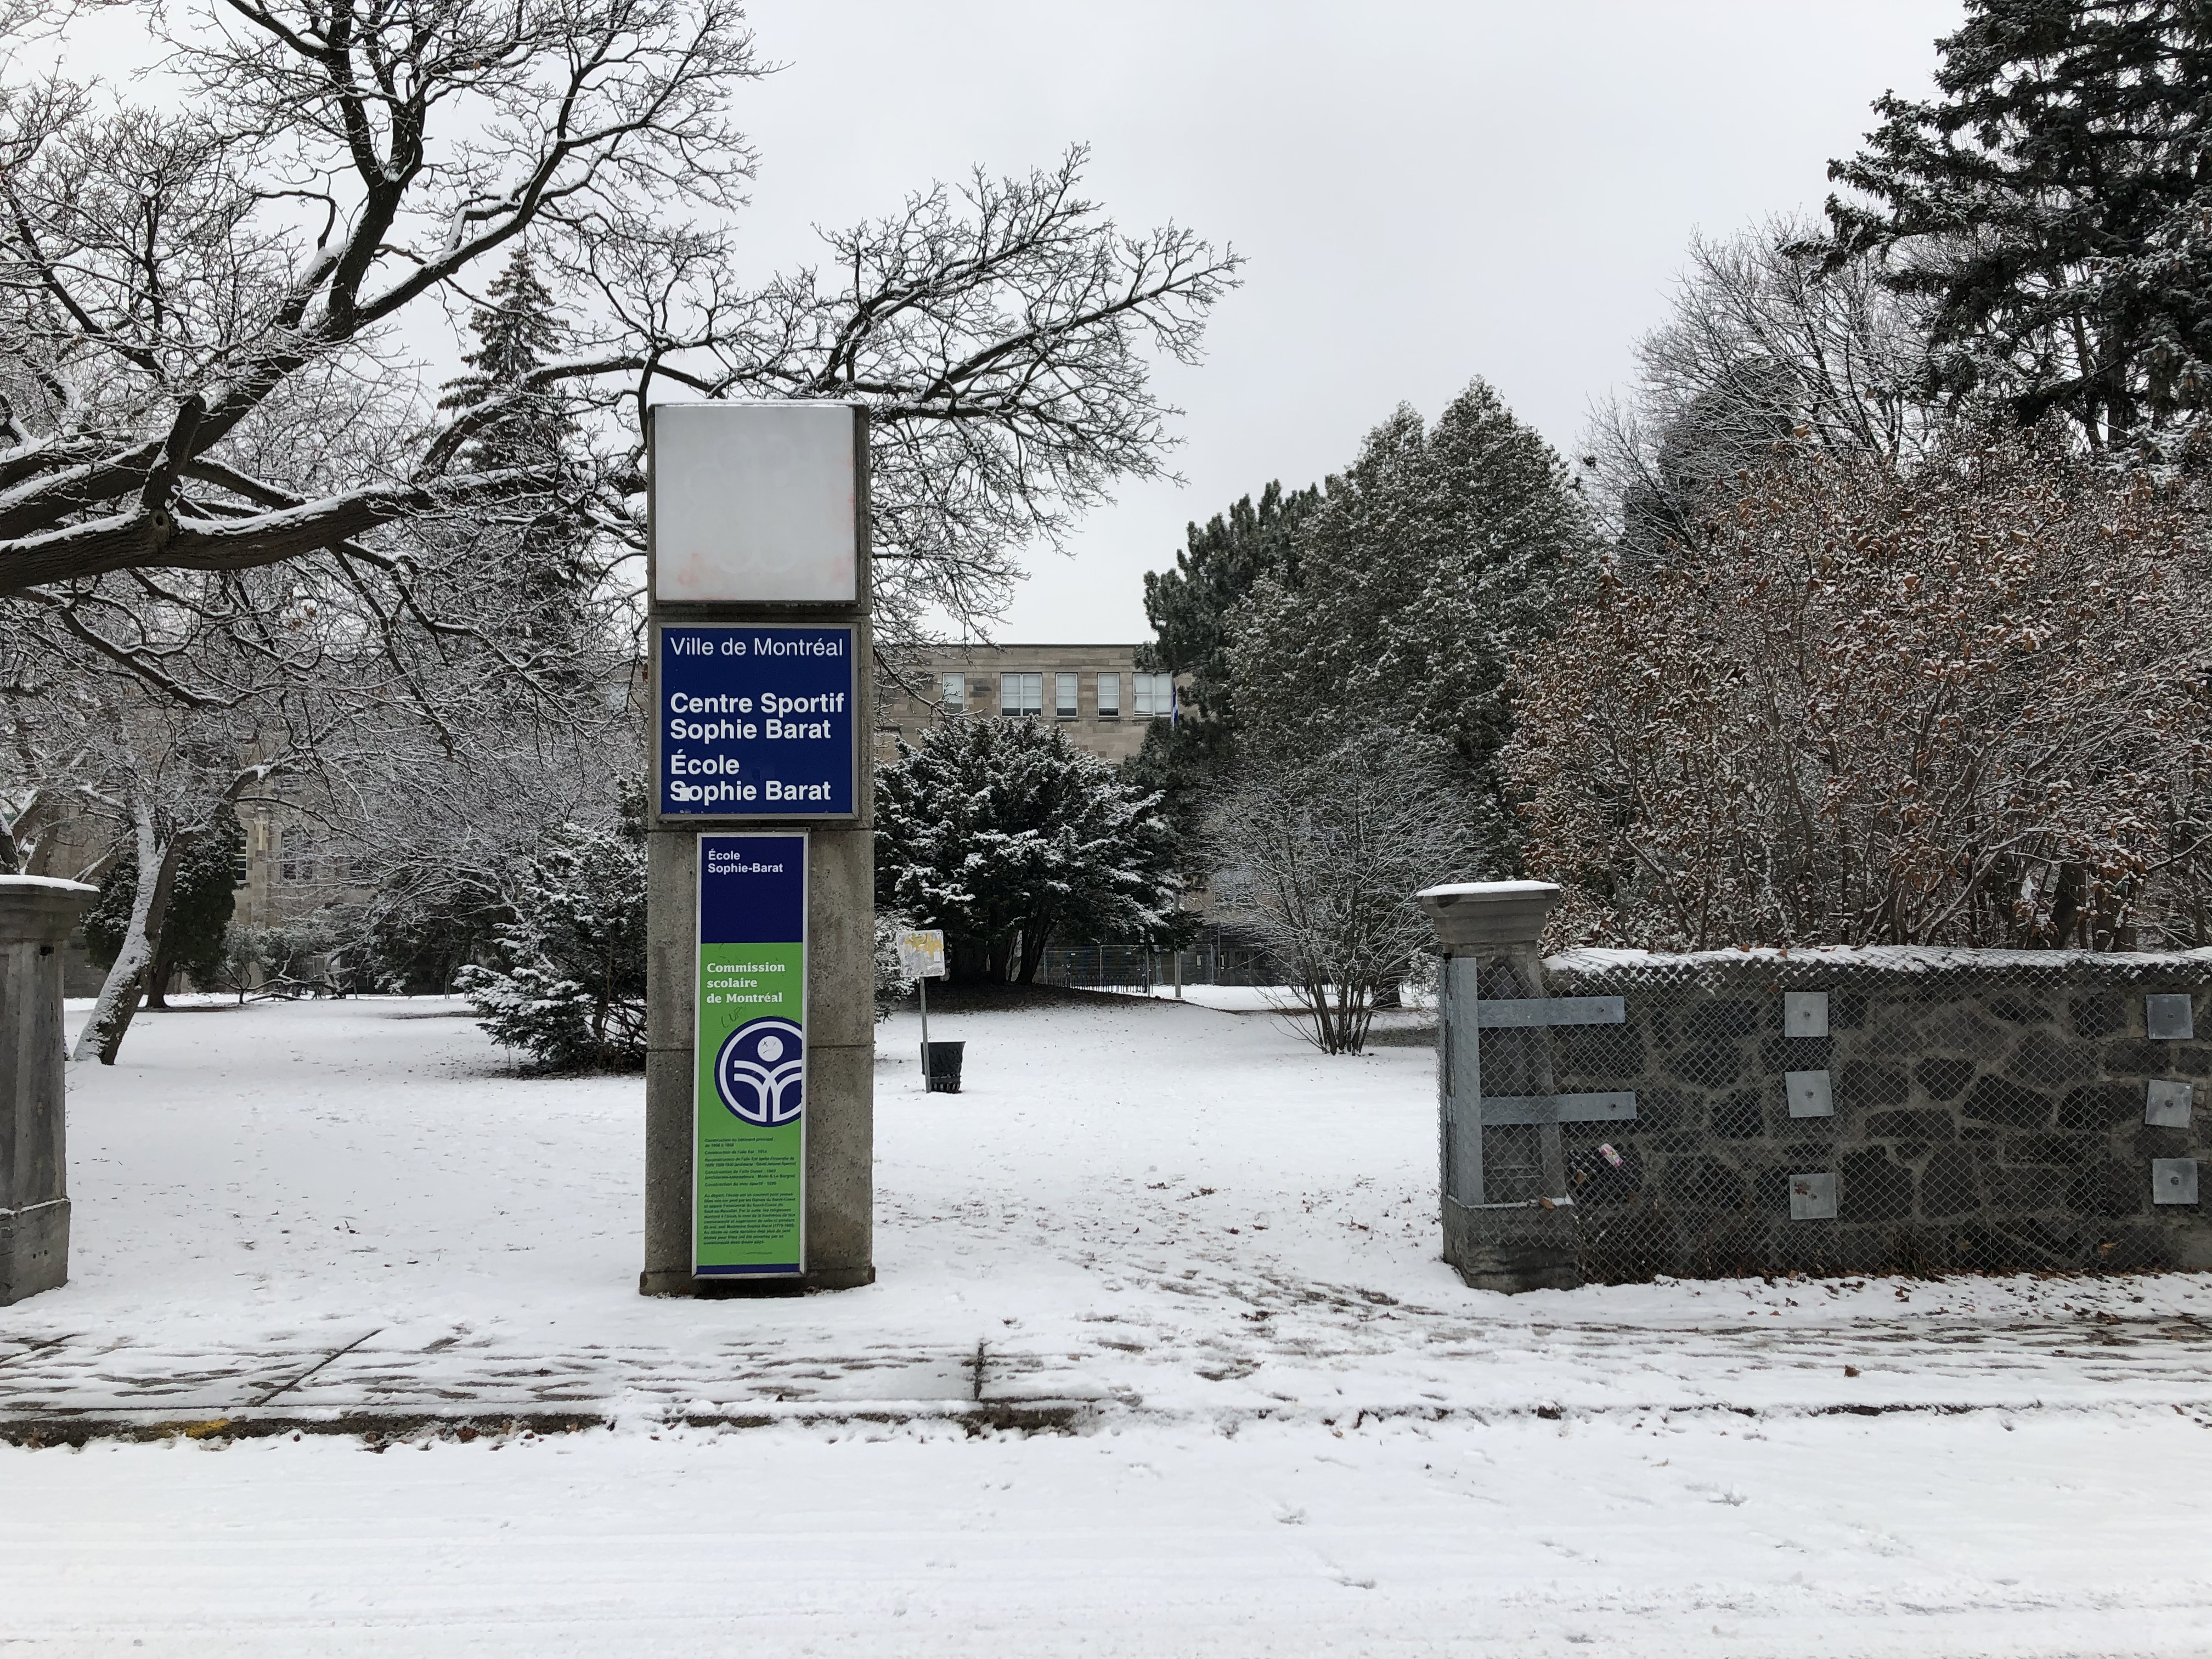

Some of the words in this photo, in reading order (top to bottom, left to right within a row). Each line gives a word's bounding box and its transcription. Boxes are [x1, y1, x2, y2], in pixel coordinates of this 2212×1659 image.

[670, 637, 714, 656] Ville
[721, 637, 747, 656] de
[754, 637, 843, 656] Montréal
[670, 692, 753, 713] Centre
[760, 692, 844, 718] Sportif
[670, 718, 757, 744] Sophie
[766, 719, 831, 739] Barat
[671, 749, 740, 775] École
[670, 780, 757, 806] Sophie
[765, 780, 831, 800] Barat
[708, 848, 741, 861] École
[708, 862, 783, 875] Sophie-Barat
[707, 962, 786, 973] Commission
[707, 977, 758, 988] scolaire
[706, 993, 722, 1003] de
[726, 992, 783, 1003] Montréal
